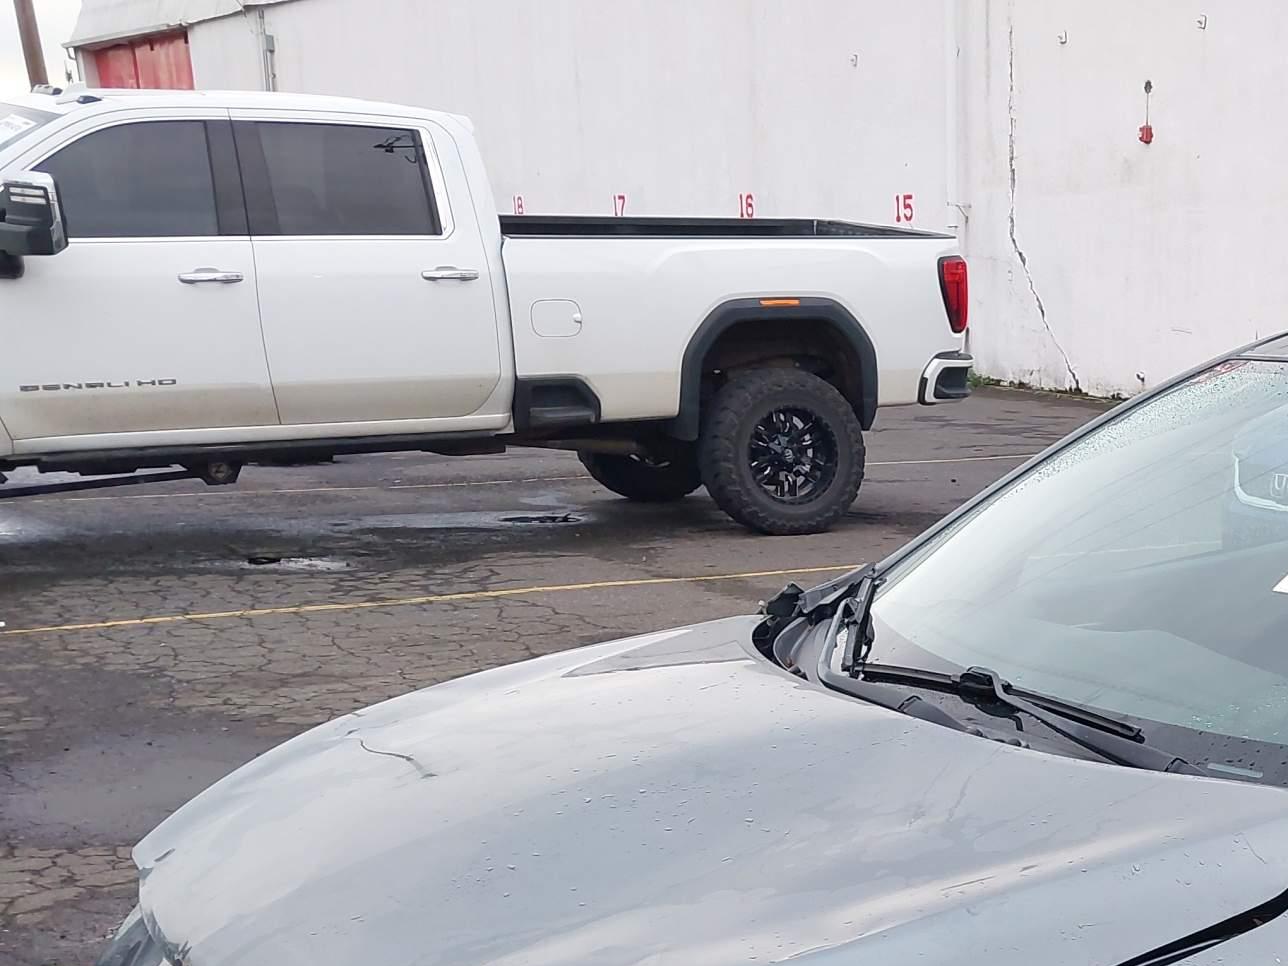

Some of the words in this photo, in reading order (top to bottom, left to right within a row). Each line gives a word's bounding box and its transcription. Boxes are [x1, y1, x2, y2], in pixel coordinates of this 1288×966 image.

[513, 196, 524, 214] 18
[613, 195, 625, 216] 17
[739, 193, 754, 218] 16
[895, 194, 914, 222] 15
[136, 378, 177, 386] HD
